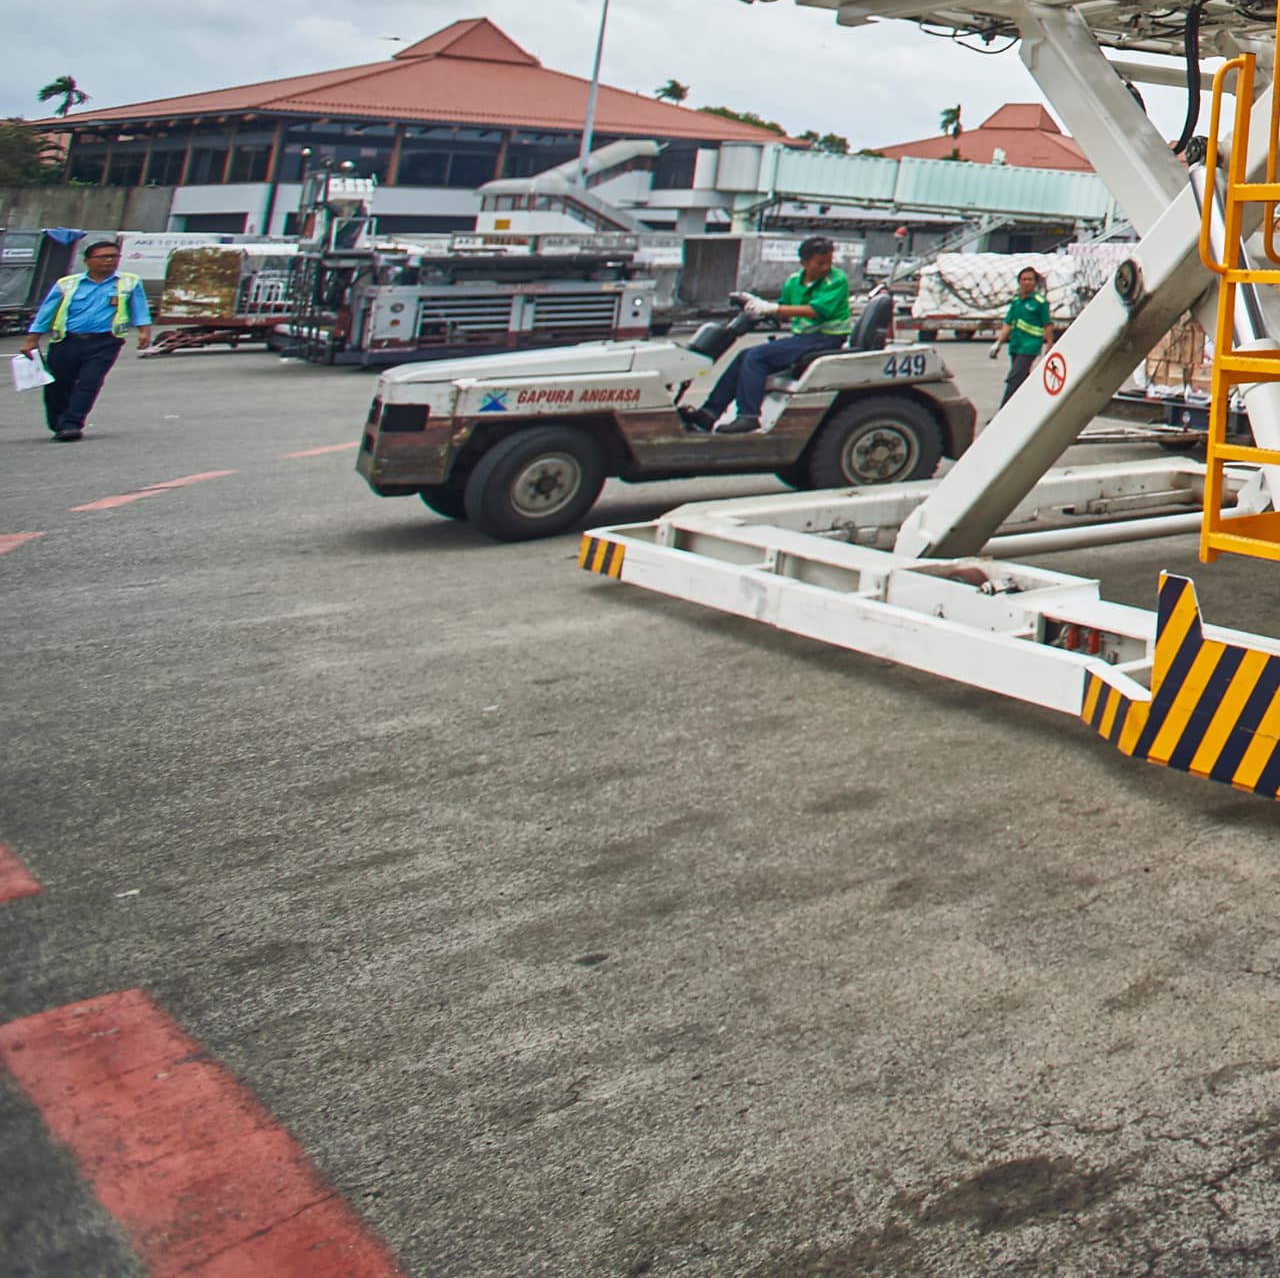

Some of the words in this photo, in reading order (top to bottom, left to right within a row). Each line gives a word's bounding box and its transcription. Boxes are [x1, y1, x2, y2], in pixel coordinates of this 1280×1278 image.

[882, 353, 926, 378] 449
[516, 389, 574, 404] GAPURA
[579, 387, 641, 402] ANGKASA
